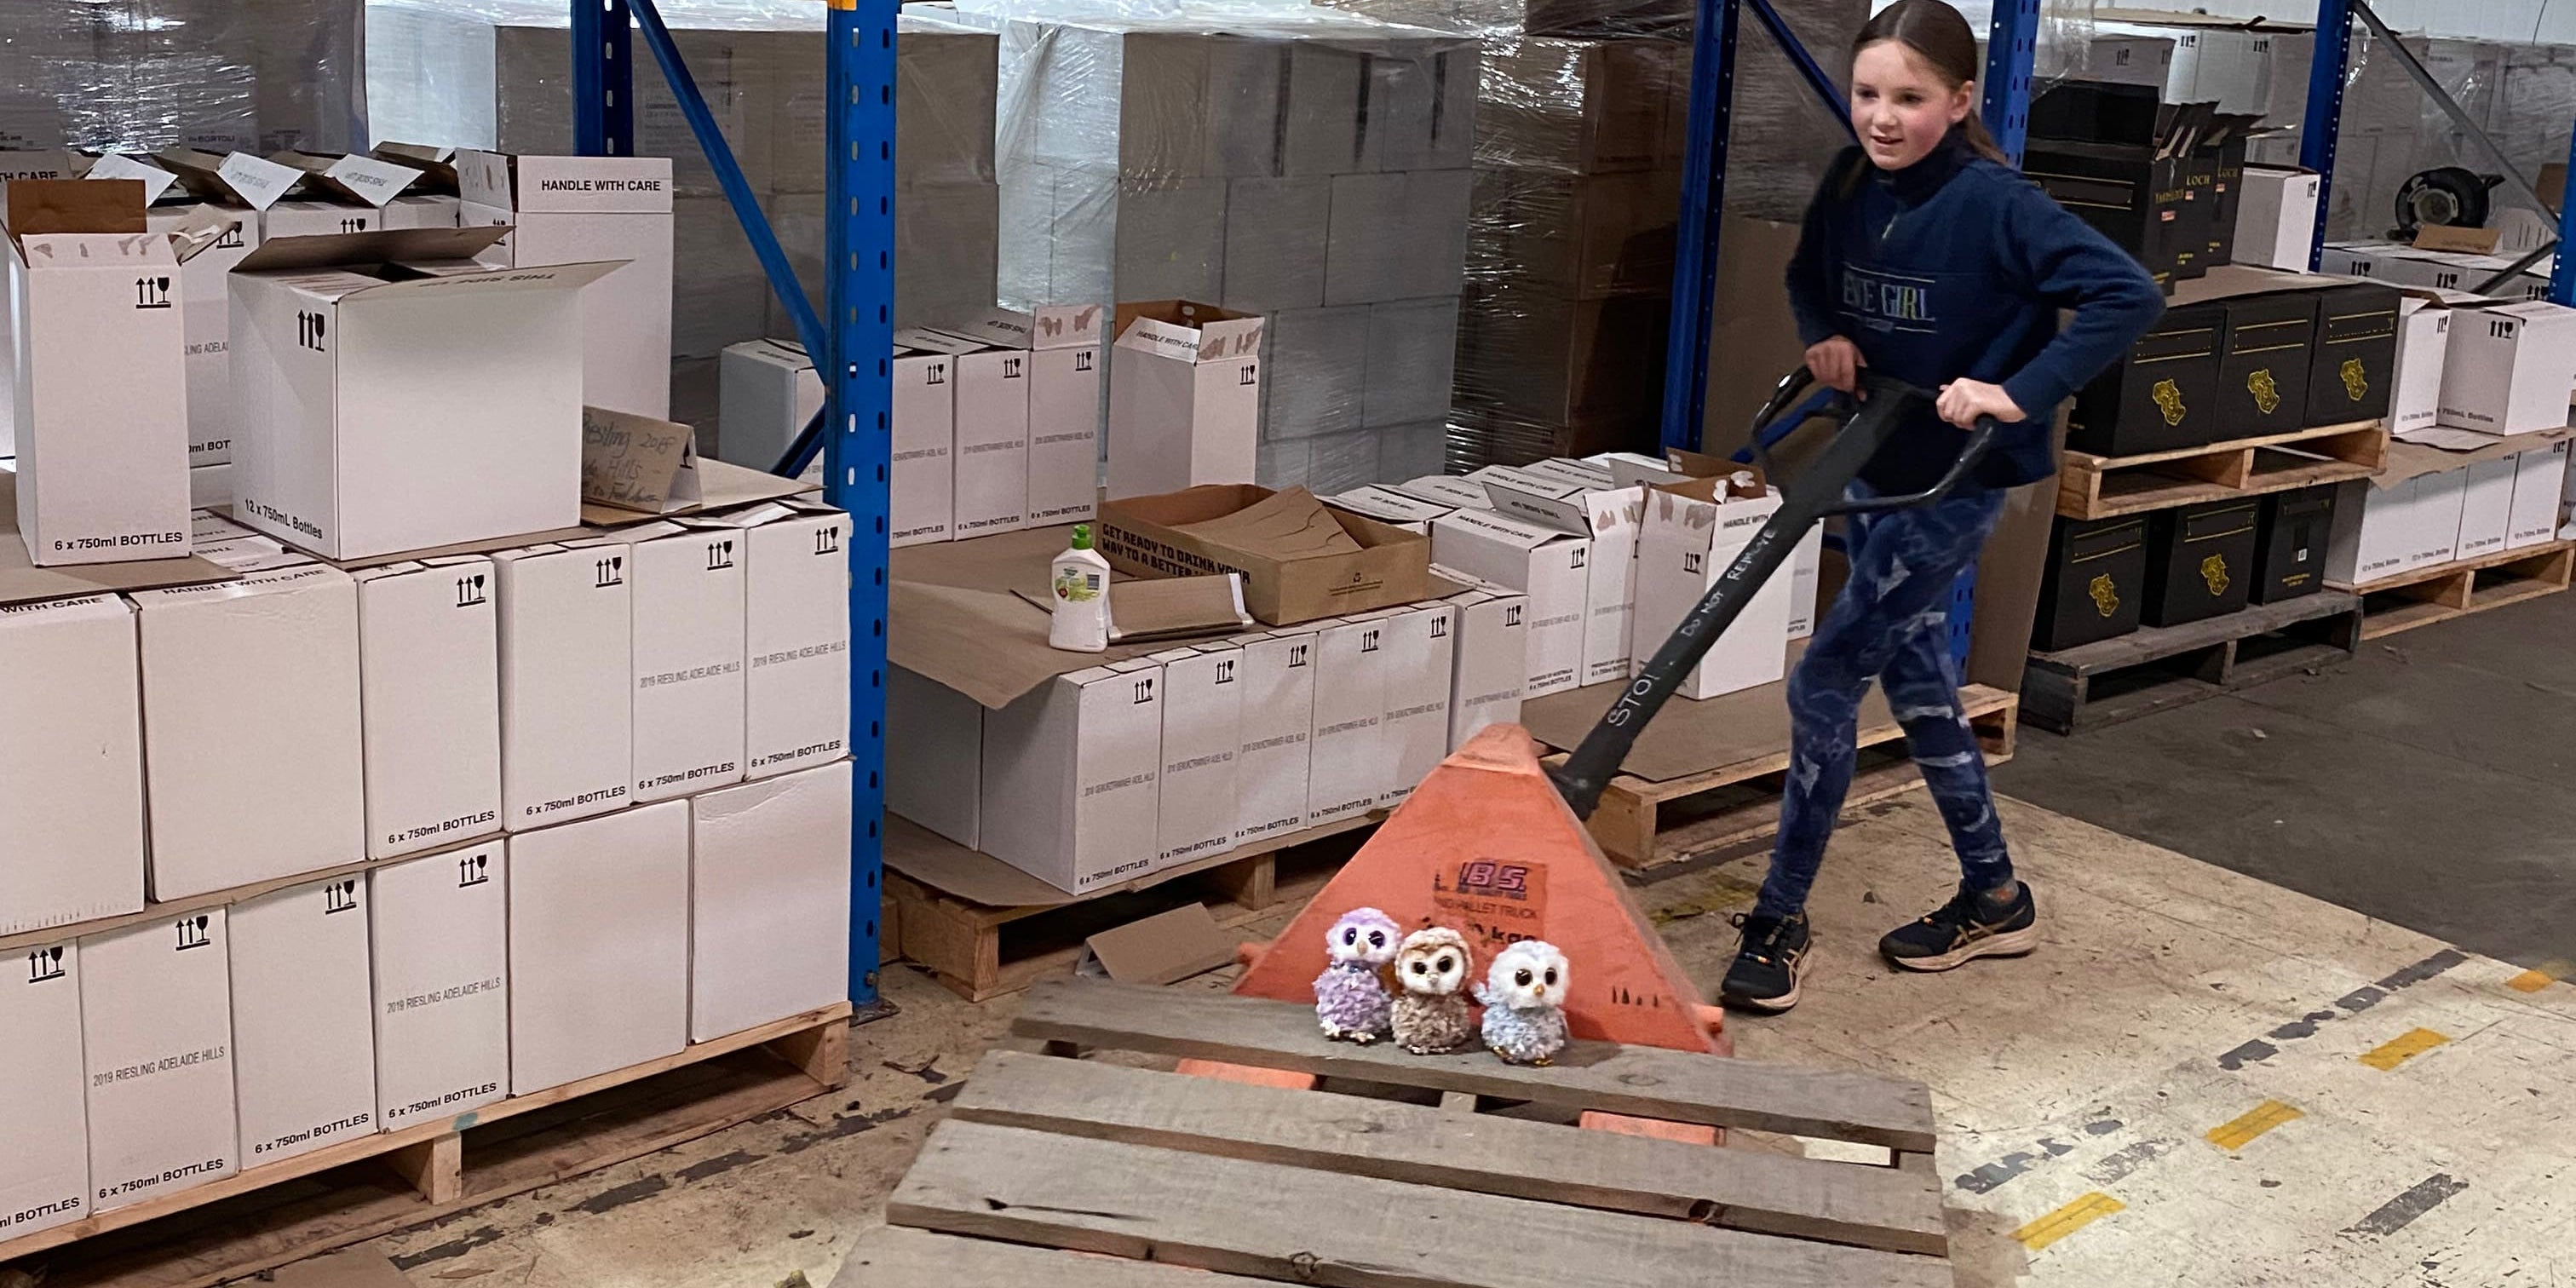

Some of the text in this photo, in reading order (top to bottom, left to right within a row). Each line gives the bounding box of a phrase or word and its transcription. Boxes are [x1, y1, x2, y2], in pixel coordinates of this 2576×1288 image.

[541, 180, 661, 192] HANDLE WITH CARE
[2186, 175, 2211, 186] LOCH
[1880, 284, 1935, 321] GIRL
[1486, 470, 1557, 492] HANDLE WITH CARE
[244, 498, 323, 539] 12 x 750mL Bottles
[989, 515, 1021, 526] BOTTLES
[1061, 504, 1091, 515] BOTTLES
[1723, 514, 1768, 529] HANDLE WITH
[912, 525, 945, 536] BOTTLES
[1458, 514, 1535, 540] HANDLE WITH CARE
[55, 539, 63, 551] 6
[66, 540, 75, 550] x
[77, 536, 118, 549] 750ml
[120, 532, 184, 547] BOTTLES
[1102, 523, 1122, 541] GET
[1123, 530, 1159, 553] READY
[1159, 543, 1175, 559] TO
[1176, 549, 1216, 573] DRINK
[1102, 538, 1192, 577] WAY TO A BETTER
[163, 569, 327, 595] HANDLE WITH CARE
[1, 597, 104, 614] WITH CARE
[768, 650, 798, 665] RIESLING
[799, 643, 829, 660] ADELAIDE
[830, 640, 846, 653] HILLS
[657, 668, 688, 685] RIESLING
[689, 664, 722, 680] ADELAIDE
[723, 660, 740, 674] HILLS
[750, 758, 757, 768] 6
[768, 750, 795, 765] 750ml
[796, 739, 841, 758] BOTTLES
[639, 762, 734, 790] 6 x 750ml BOTTLES
[526, 785, 626, 816] 6 x 750ml BOTTLES
[1342, 797, 1372, 811] BOTTLES
[388, 810, 495, 844] 6 x 750ml BOTTLES
[1246, 822, 1267, 836] 750ml
[1267, 816, 1299, 831] BOTTLES
[1171, 843, 1193, 858] 750ml
[1193, 836, 1227, 852] BOTTLES
[1091, 867, 1113, 882] 750ml
[1114, 858, 1149, 875] BOTTLES
[387, 977, 501, 1014] 2019 RIESLING ADELAIDE HILLS
[94, 1045, 225, 1087] 2019 RIESLING ADELAIDE HILLS
[388, 1109, 396, 1118] 6
[408, 1096, 441, 1114] 750ml
[444, 1082, 497, 1104] BOTTLES
[255, 1113, 370, 1153] 6 x 750ml BOTTLES
[99, 1158, 224, 1199] 6 x 750ml BOTTLES
[15, 1196, 80, 1223] BOTTLES
